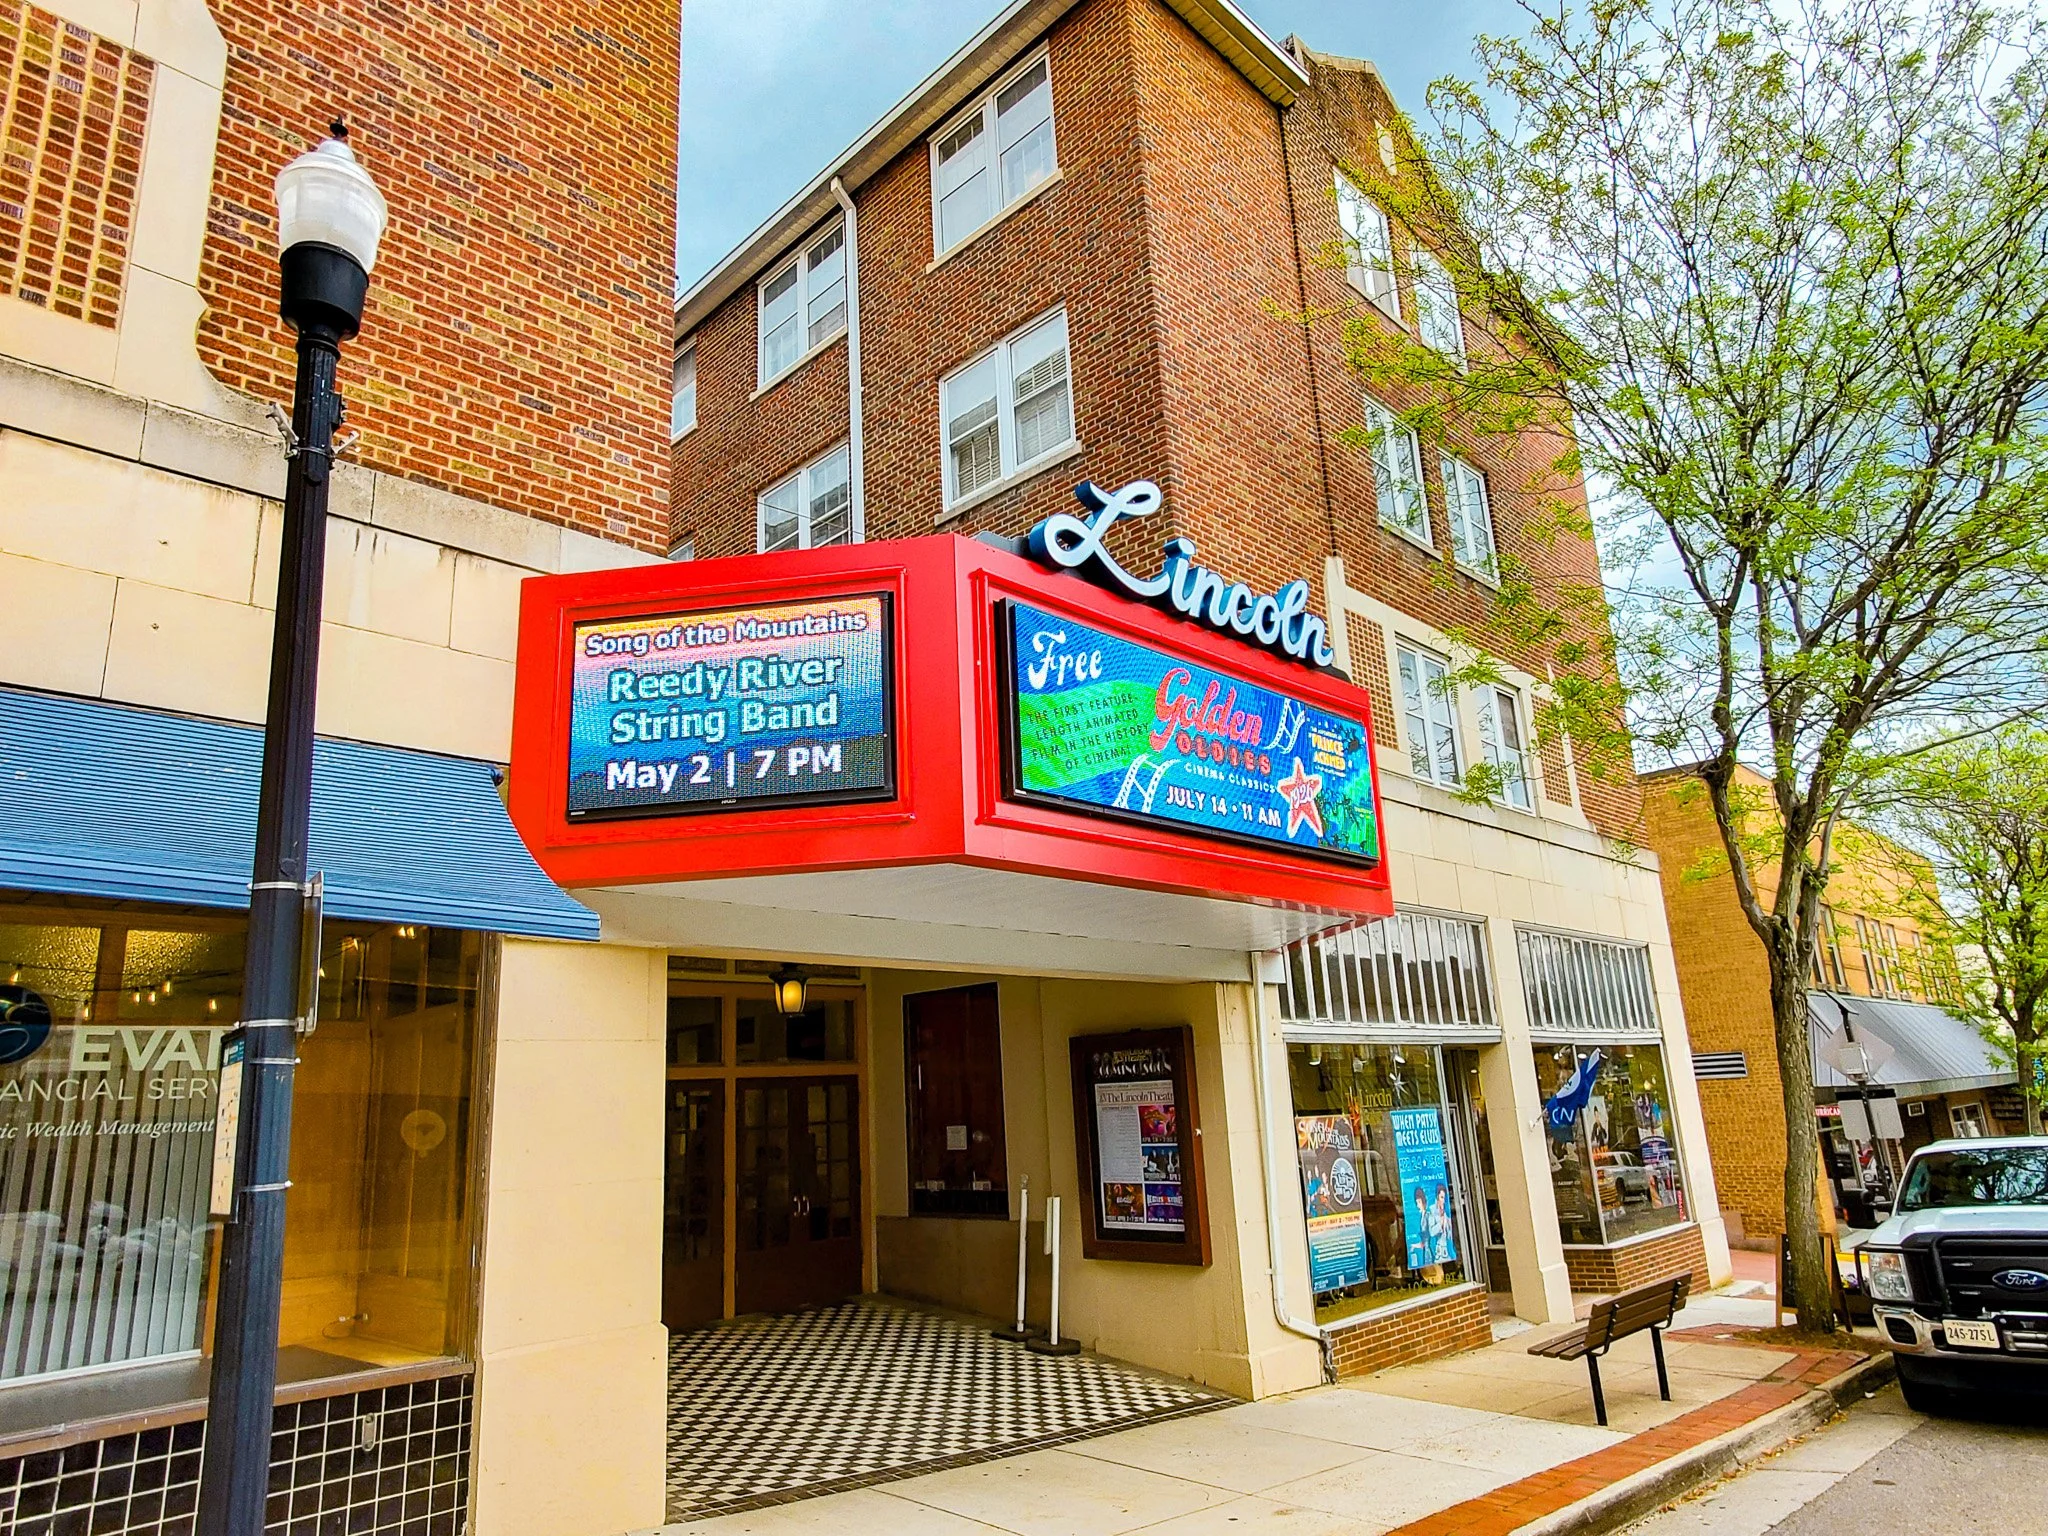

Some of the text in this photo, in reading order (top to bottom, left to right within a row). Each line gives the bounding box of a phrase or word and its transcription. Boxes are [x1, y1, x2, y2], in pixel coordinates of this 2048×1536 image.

[1030, 479, 1334, 667] Lincoln
[586, 611, 867, 656] Song of the Mountains
[608, 655, 842, 702] Reedy River
[1027, 630, 1103, 690] Free
[611, 693, 838, 744] String Band
[1028, 710, 1049, 723] THE
[1054, 702, 1084, 717] FIRST
[1036, 708, 1138, 741] LENGTH ANIMATED
[1150, 667, 1263, 752] Golden
[1032, 722, 1149, 761] FILM IN THE HISTORY
[1175, 730, 1272, 776] OLDIES
[606, 760, 678, 794] May
[690, 755, 711, 784] 2
[754, 750, 775, 779] 7
[788, 745, 842, 776] PM
[1065, 758, 1079, 771] OF
[1184, 762, 1276, 793] CINEMA CLASSICS
[1166, 785, 1206, 811] JULY
[1211, 796, 1228, 816] 14
[1241, 802, 1253, 821] 11
[1258, 807, 1282, 828] AM
[26, 1119, 92, 1138] Wealth
[96, 1117, 214, 1139] Management
[2006, 1273, 2038, 1285] Ford
